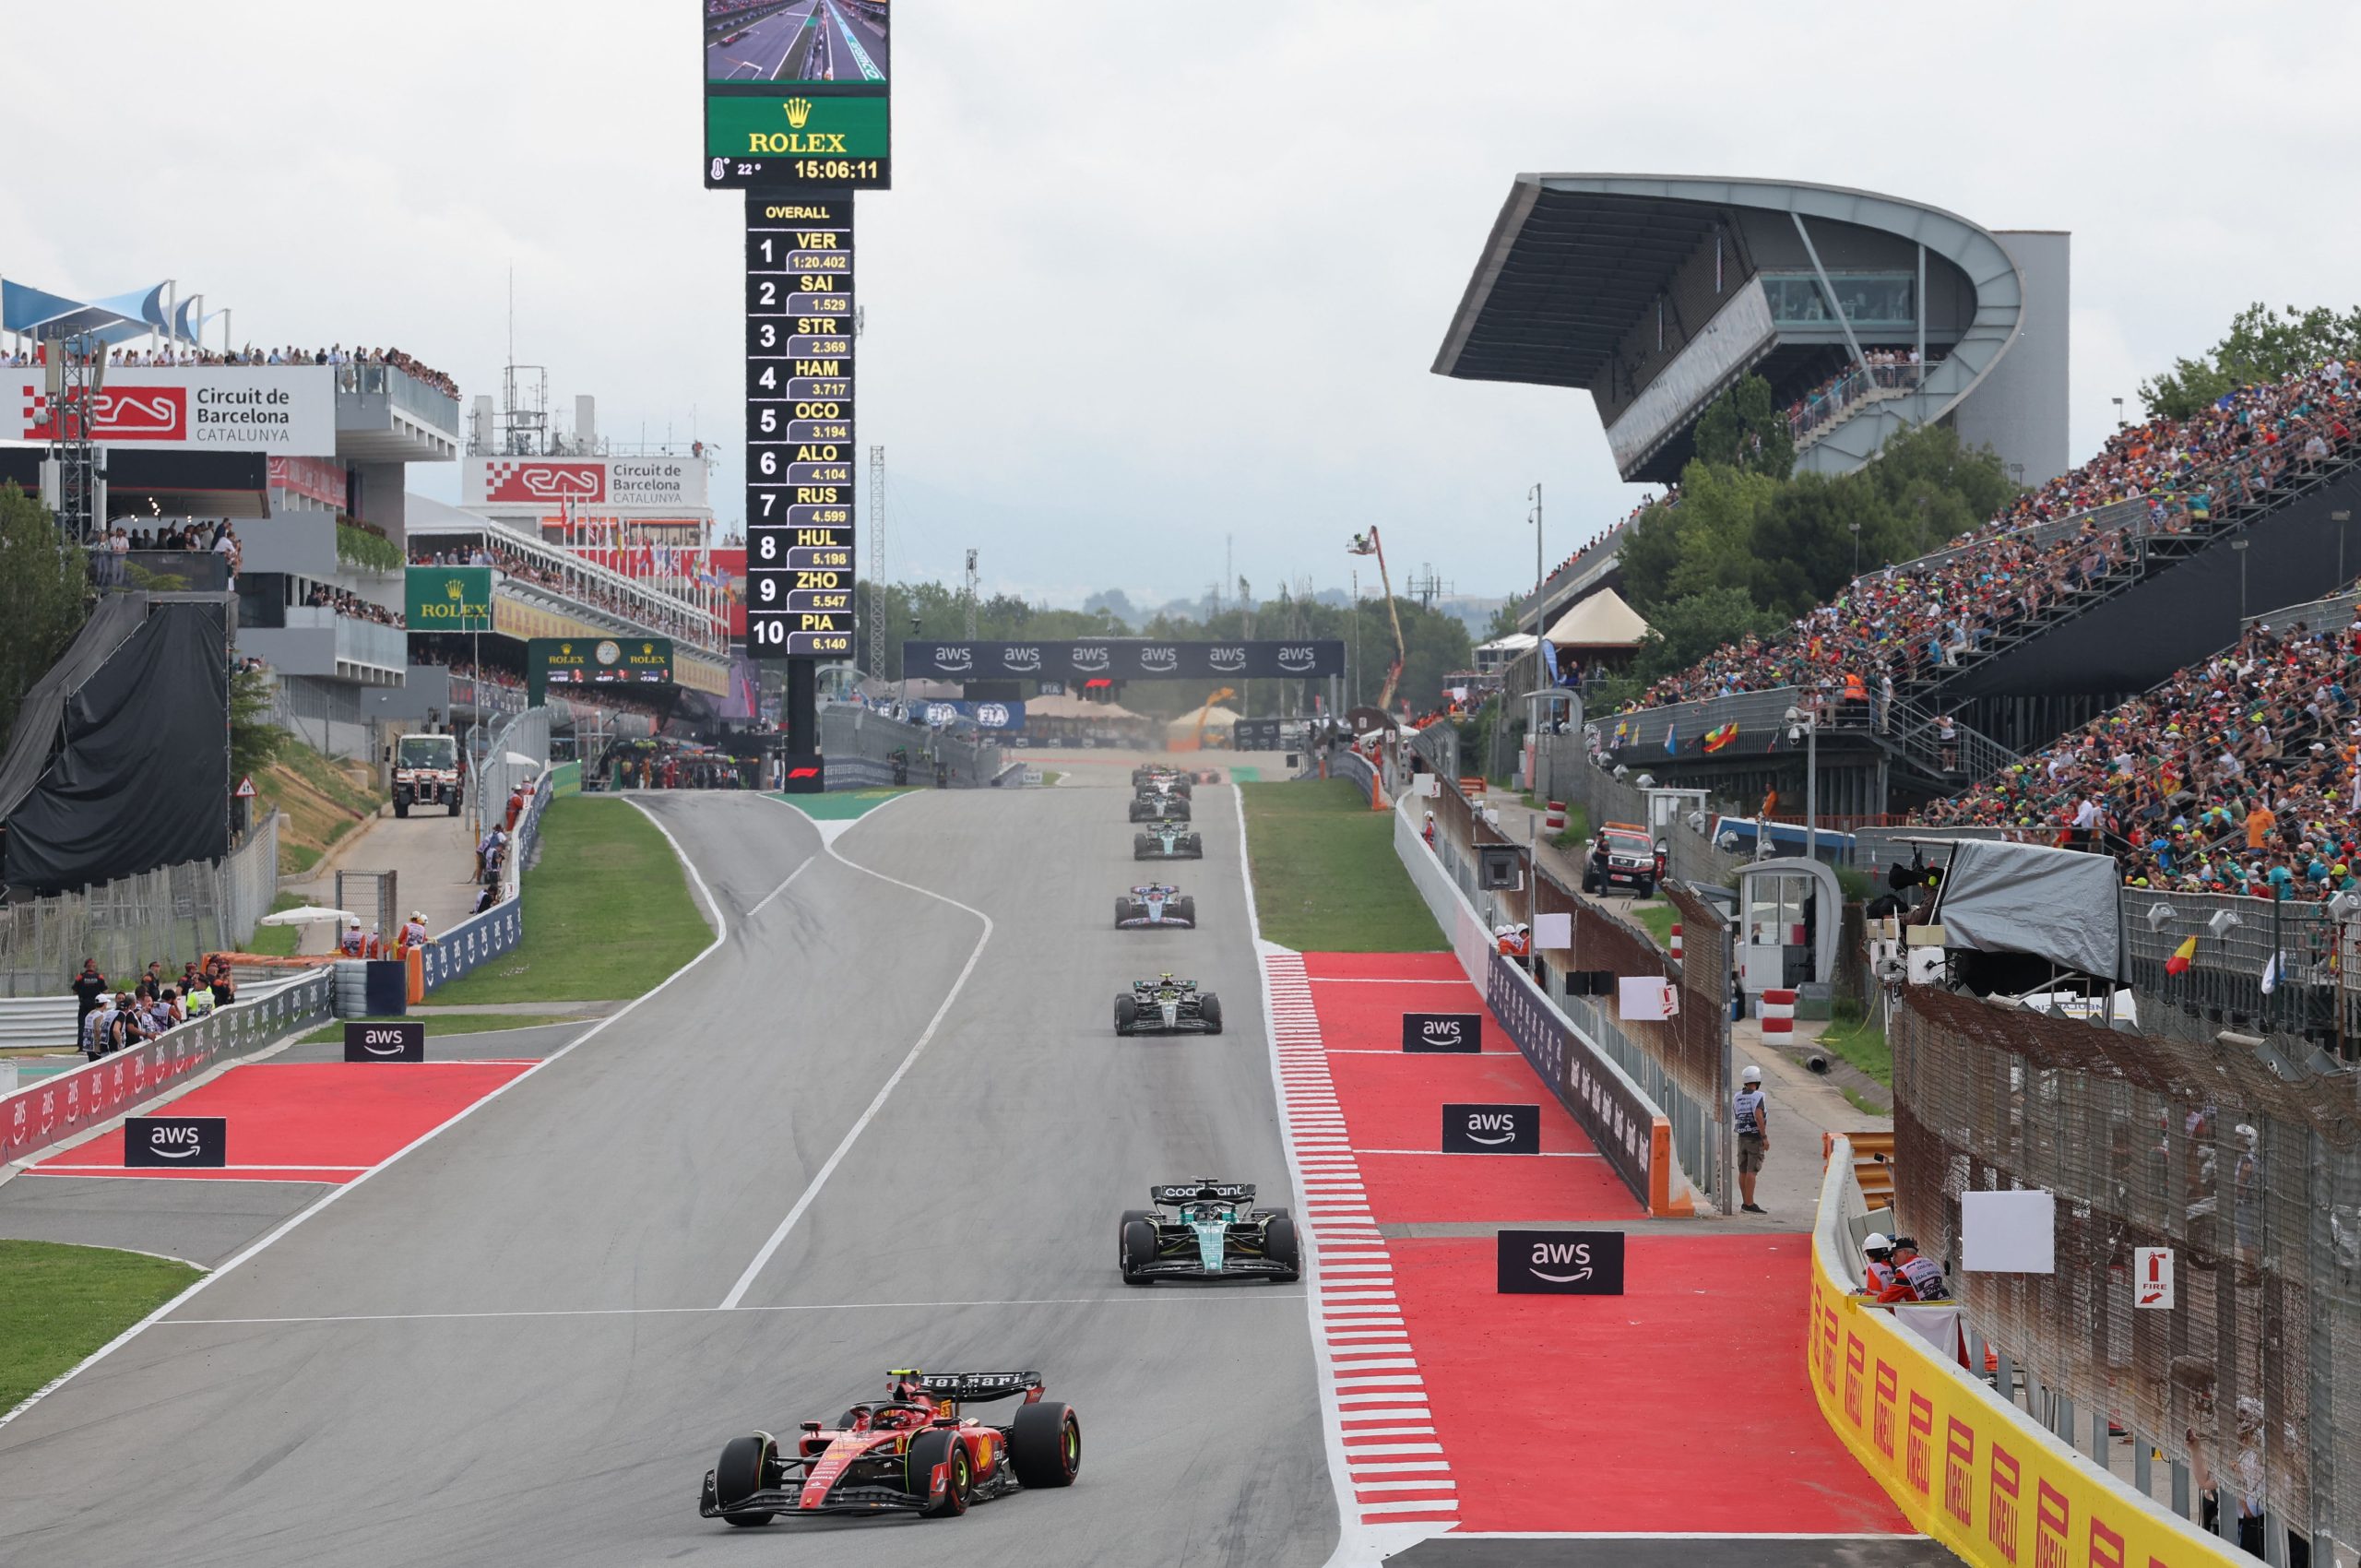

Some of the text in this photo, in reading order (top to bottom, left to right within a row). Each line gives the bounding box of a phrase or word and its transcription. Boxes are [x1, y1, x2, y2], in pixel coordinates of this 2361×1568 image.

[749, 134, 847, 152] ROLEX
[795, 160, 877, 178] 15:06:11
[765, 207, 829, 219] OVERALL
[797, 233, 836, 248] VER
[760, 240, 773, 262] 1
[792, 256, 846, 268] 1:20.402
[801, 276, 833, 291] SAI
[760, 282, 776, 304] 2
[813, 299, 847, 311] 1.529
[798, 318, 836, 333] STR
[760, 325, 776, 347] 3
[813, 341, 847, 353] 2.369
[796, 361, 838, 375] HAM
[760, 367, 776, 389] 4
[196, 387, 290, 405] Circuit de
[813, 384, 847, 396] 3.717
[196, 408, 290, 424] Barcelona
[796, 403, 838, 419] OCO
[760, 410, 776, 432] 5
[196, 428, 290, 442] CATALUNYA
[813, 426, 847, 438] 3.194
[797, 445, 836, 460] ALO
[760, 452, 776, 474] 6
[613, 464, 682, 477] Circuit de
[813, 469, 847, 481] 4.104
[613, 479, 681, 491] Barcelona
[613, 493, 682, 504] CATALUNYA
[798, 488, 836, 504] RUS
[760, 494, 776, 517] 7
[813, 511, 847, 523] 4.599
[798, 530, 836, 546] HUL
[760, 536, 776, 559] 8
[813, 553, 847, 565] 5.198
[797, 572, 837, 588] ZHO
[760, 579, 776, 601] 9
[813, 596, 847, 608] 5.547
[421, 604, 488, 618] ROLEX
[801, 615, 833, 631] PIA
[753, 621, 784, 643] 10
[813, 638, 847, 650] 6.140
[549, 655, 585, 664] ROLEX
[630, 655, 666, 664] ROLEX
[935, 647, 971, 660] aws
[1004, 647, 1040, 661] aws
[1072, 647, 1108, 661] aws
[1141, 647, 1176, 661] aws
[1209, 647, 1245, 661] aws
[1277, 647, 1314, 660] aws
[979, 709, 1005, 721] FIA
[1423, 1021, 1460, 1035] aws
[365, 1030, 403, 1044] aws
[15, 1100, 26, 1126] aws
[42, 1090, 53, 1116] aws
[68, 1079, 78, 1104] aws
[92, 1073, 101, 1095] aws
[114, 1063, 124, 1086] aws
[1468, 1113, 1514, 1131] aws
[151, 1126, 199, 1144] aws
[1532, 1242, 1591, 1265] aws
[1845, 1329, 1865, 1429] PIRELLI
[1874, 1358, 1897, 1461] PIRELLI
[1907, 1388, 1932, 1496] PIRELLI
[1945, 1414, 1974, 1527] PIRELLI
[1989, 1442, 2020, 1565] PIRELLI
